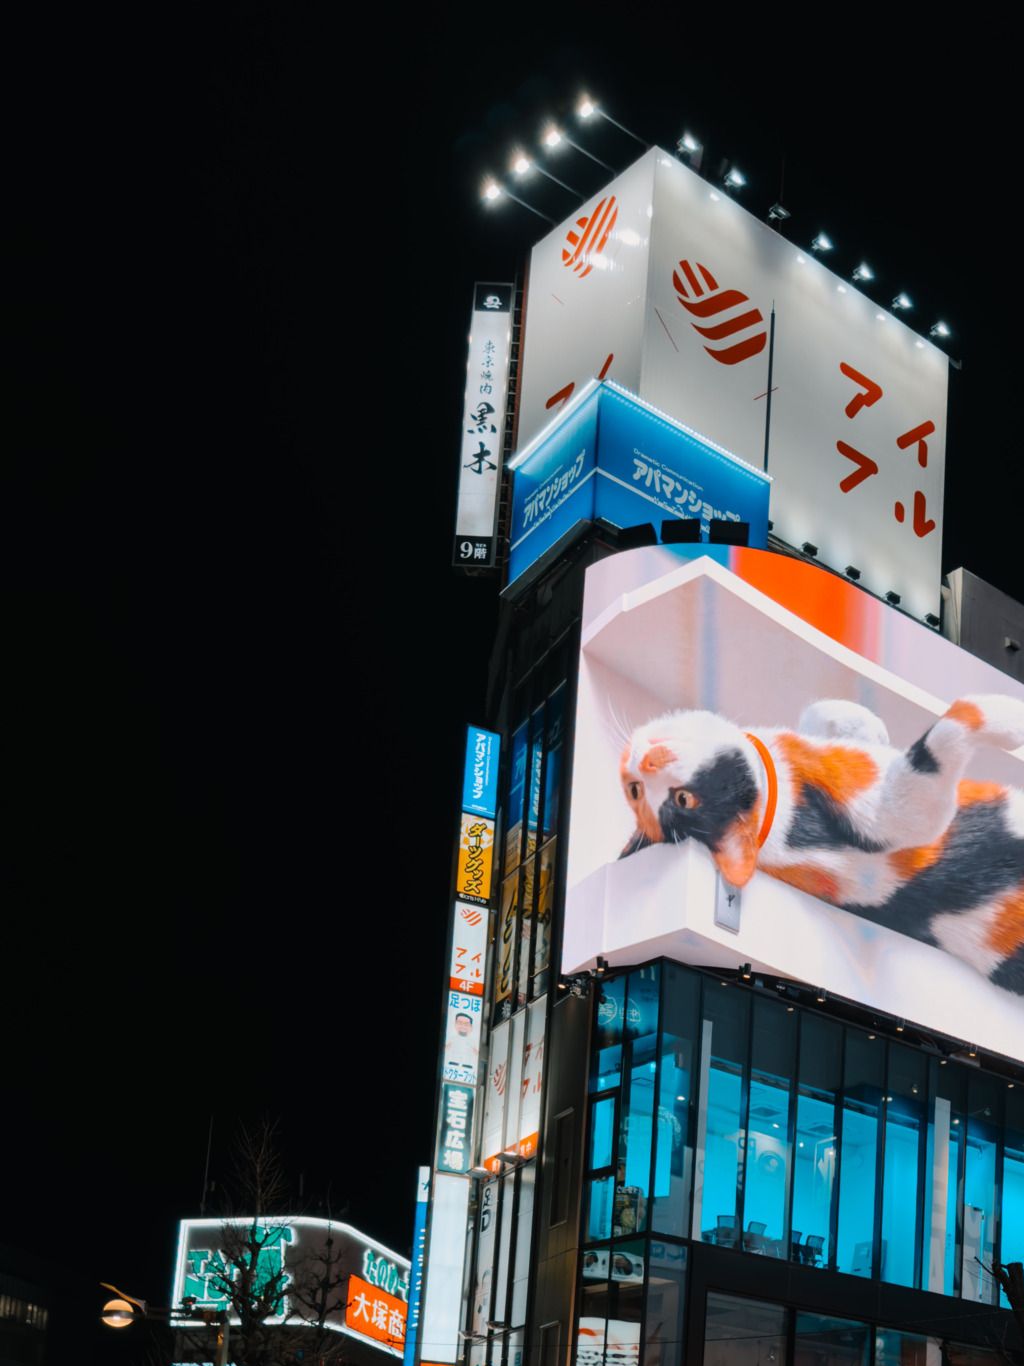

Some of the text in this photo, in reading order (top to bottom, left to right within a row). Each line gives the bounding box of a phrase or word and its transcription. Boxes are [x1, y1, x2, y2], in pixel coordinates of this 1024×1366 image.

[463, 402, 497, 475] 黒木
[522, 448, 586, 529] アパマンショップ
[632, 458, 742, 522] アパマンショップ
[460, 542, 487, 560] 9階
[459, 980, 475, 992] 4F
